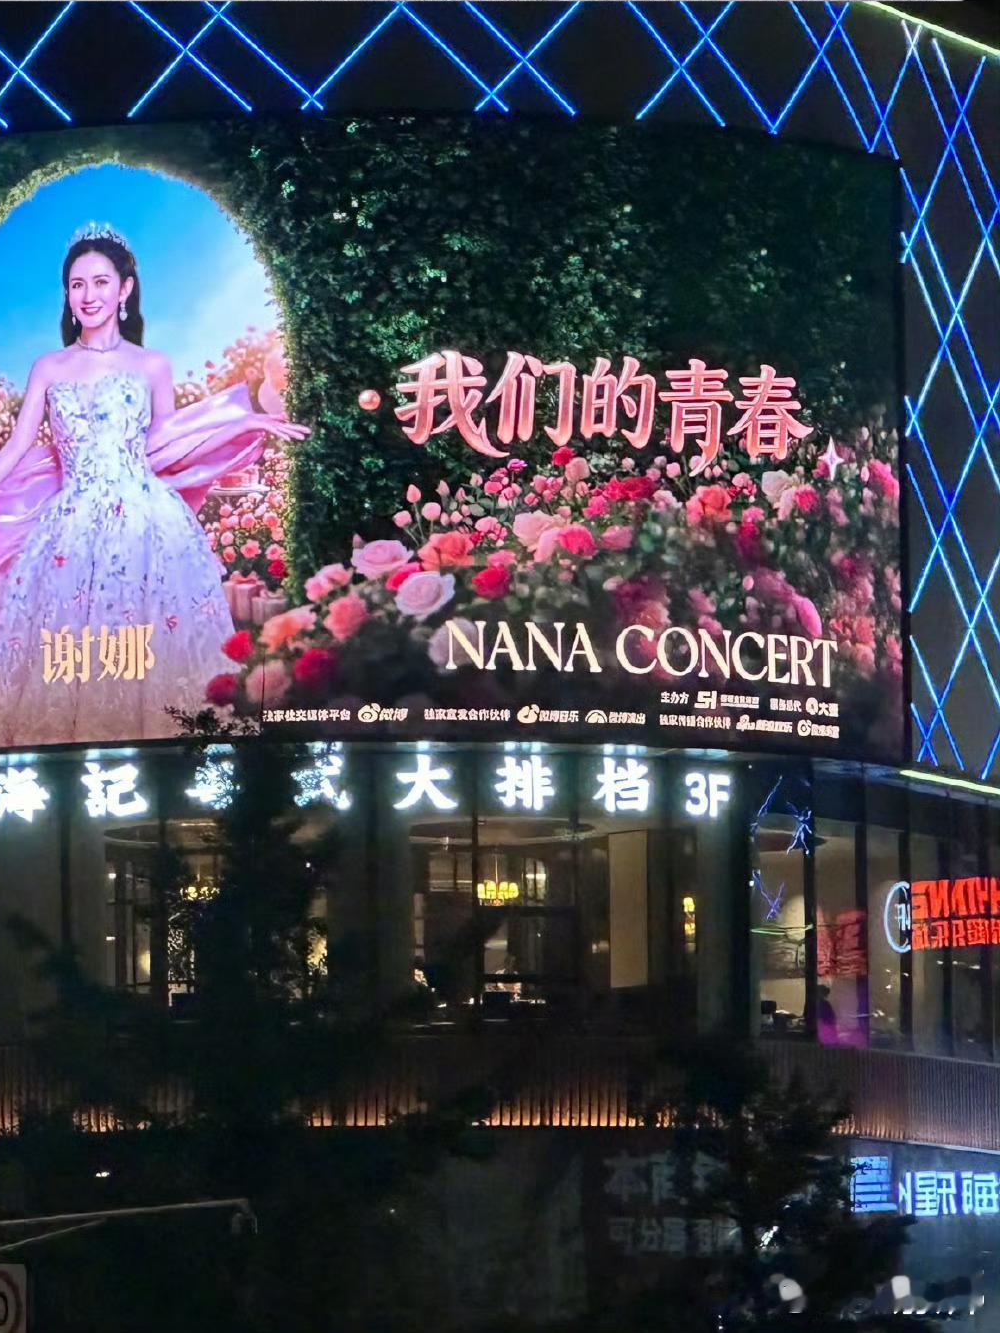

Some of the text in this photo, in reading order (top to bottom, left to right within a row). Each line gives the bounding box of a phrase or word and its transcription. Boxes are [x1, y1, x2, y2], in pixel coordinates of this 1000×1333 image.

[394, 350, 814, 477] 我们的青春
[39, 622, 156, 685] 谢娜
[445, 619, 838, 689] NANA CONCERT
[660, 691, 690, 705] 主办方
[684, 772, 731, 817] 3F
